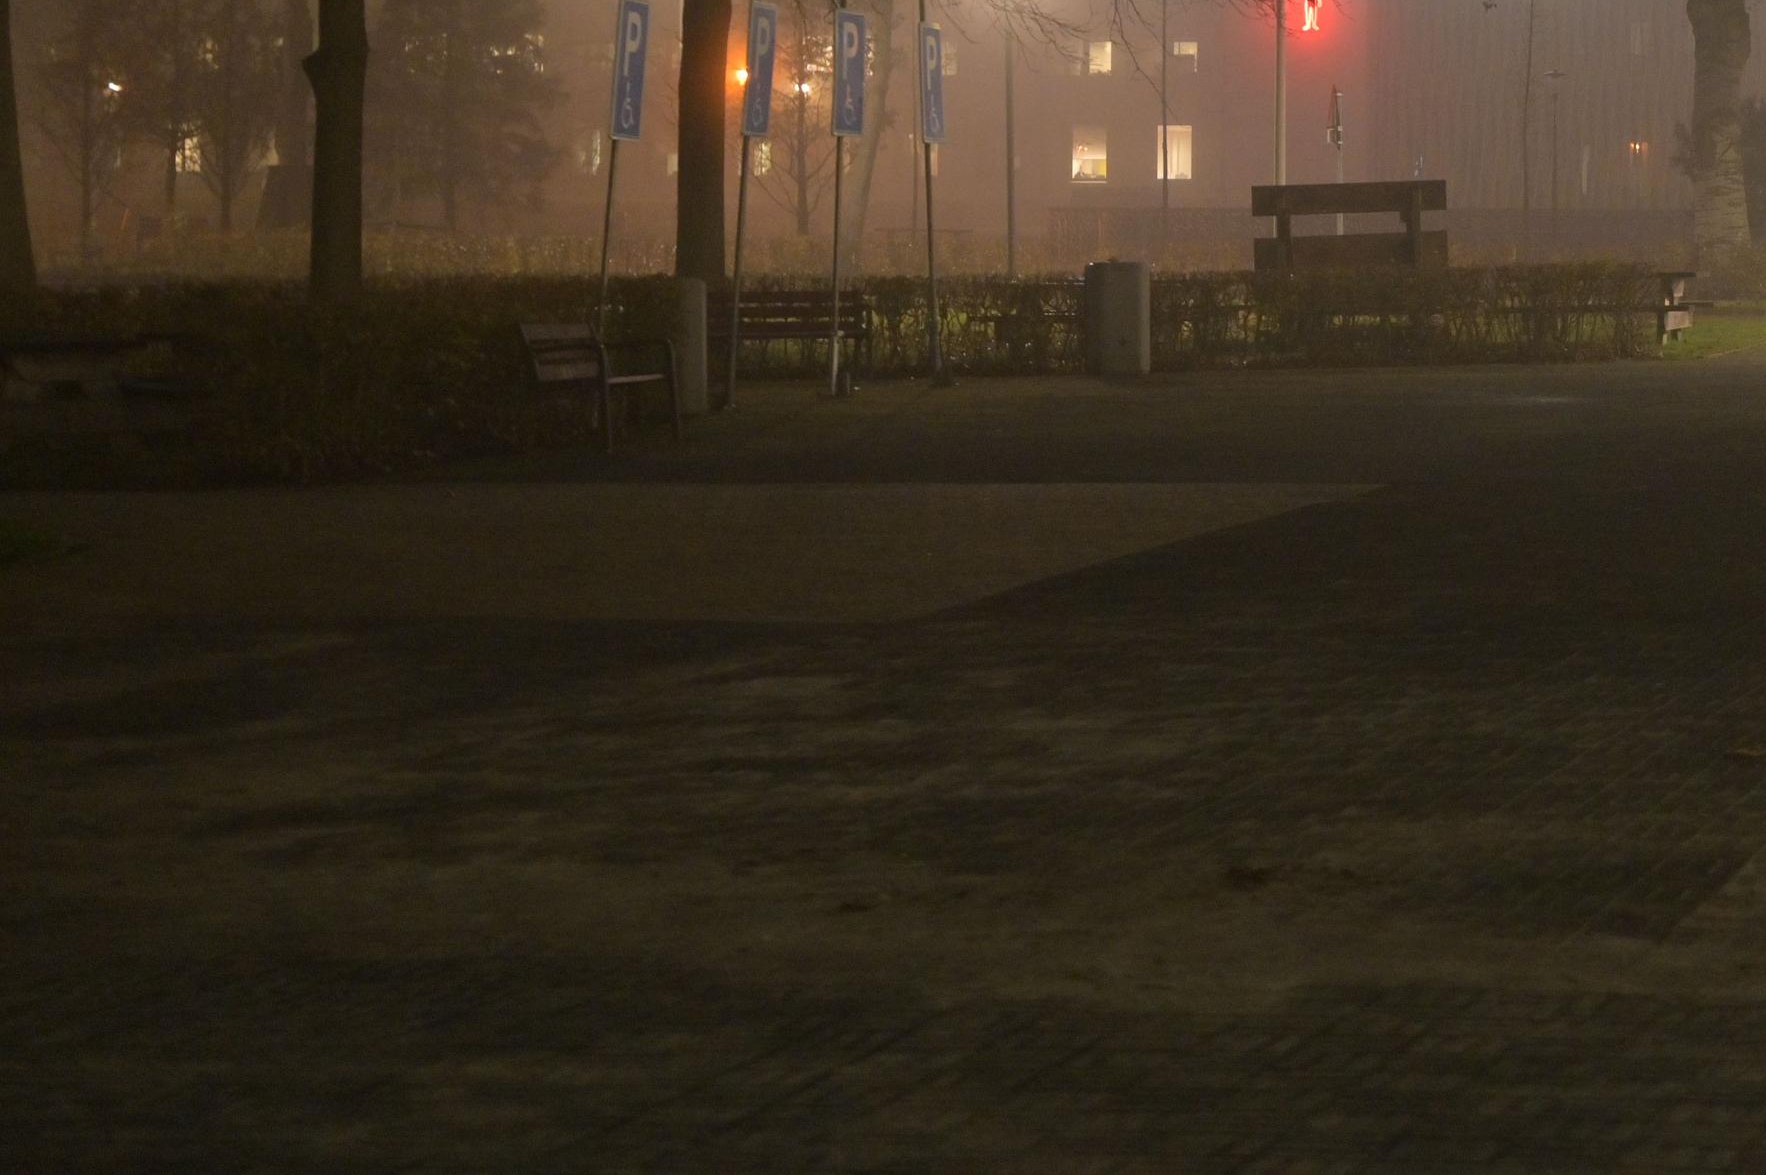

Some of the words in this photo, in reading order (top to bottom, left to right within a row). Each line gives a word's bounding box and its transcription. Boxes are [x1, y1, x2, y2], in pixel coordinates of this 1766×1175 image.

[623, 11, 642, 77] P
[753, 16, 770, 80] P
[843, 21, 858, 80] P
[925, 35, 937, 90] P
